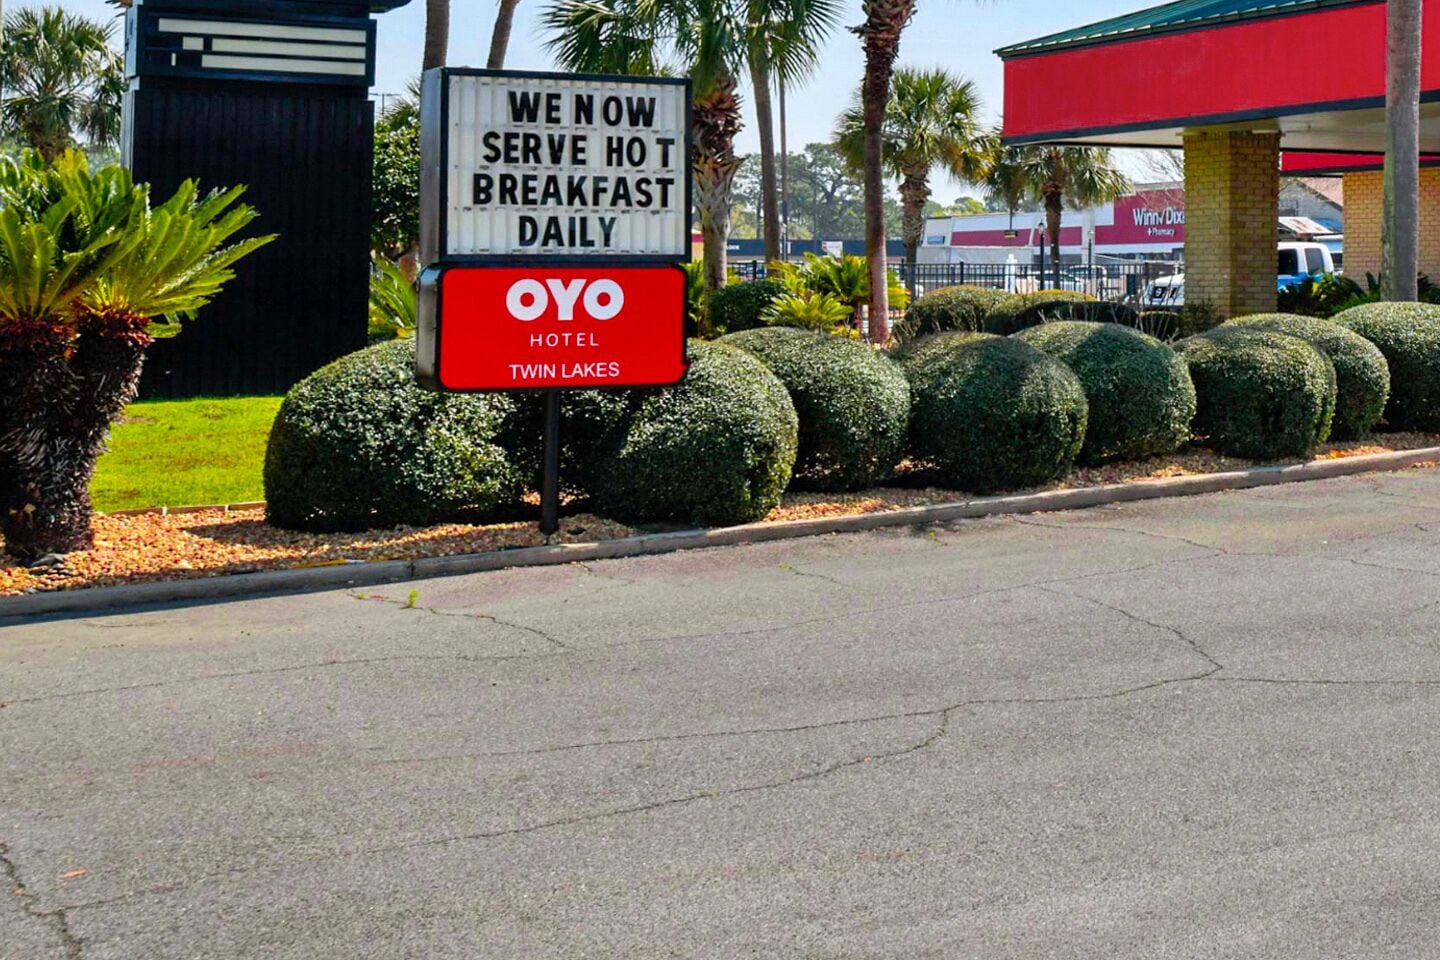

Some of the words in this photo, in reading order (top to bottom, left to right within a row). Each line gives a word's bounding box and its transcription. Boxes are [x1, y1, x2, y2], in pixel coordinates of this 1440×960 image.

[508, 91, 561, 124] WE
[574, 94, 656, 127] NOW
[482, 131, 587, 165] SERVE
[605, 136, 675, 168] HOT
[472, 173, 675, 208] BREAKFAST
[518, 215, 616, 247] DAILY
[506, 278, 624, 321] OYO
[530, 333, 599, 347] HOTEL
[509, 364, 556, 379] TWIN
[561, 362, 620, 378] LAKES
